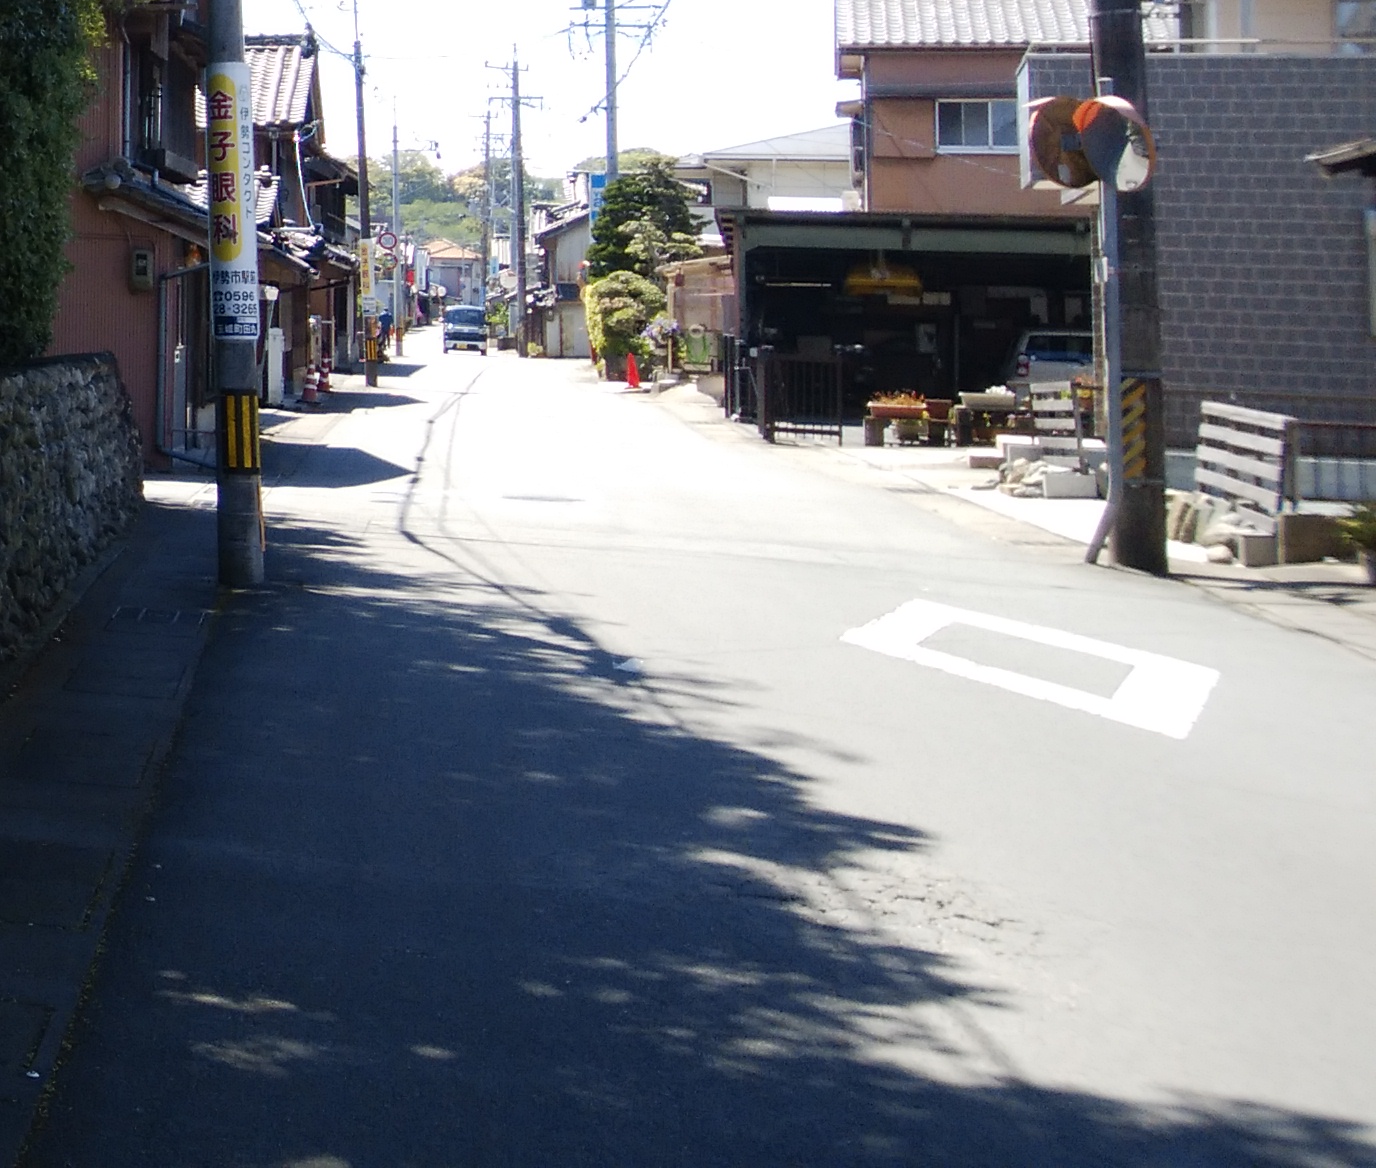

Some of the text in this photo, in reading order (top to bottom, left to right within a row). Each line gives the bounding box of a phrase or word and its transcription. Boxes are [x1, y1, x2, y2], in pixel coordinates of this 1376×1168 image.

[210, 90, 238, 245] 金子眼科
[224, 291, 255, 302] 0596
